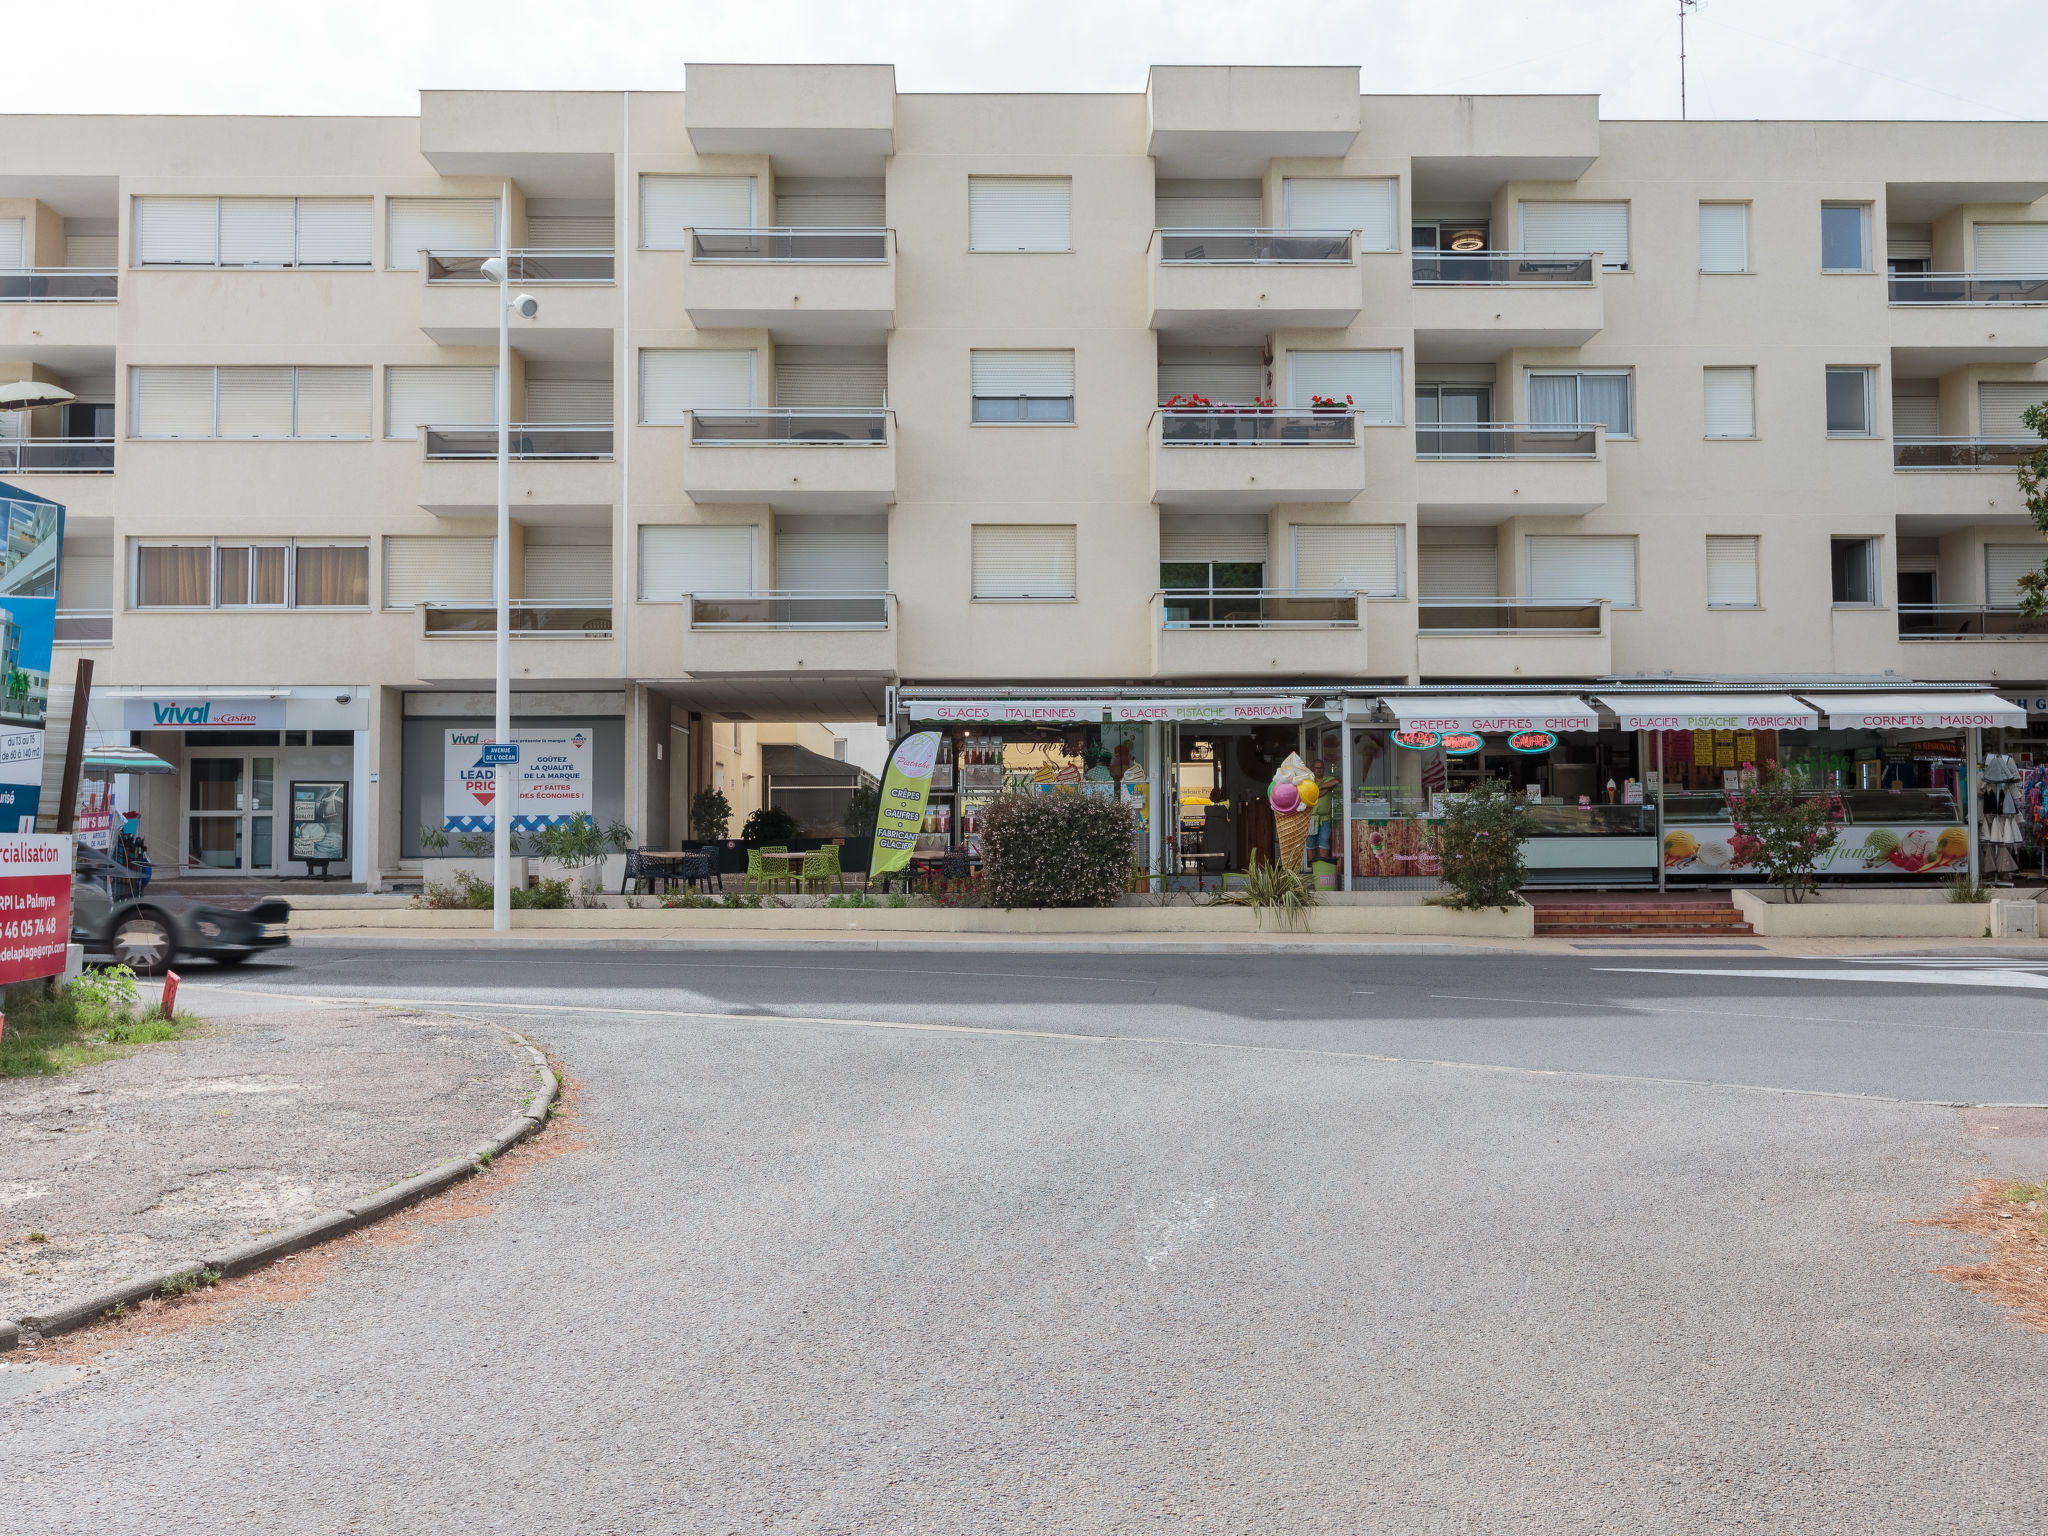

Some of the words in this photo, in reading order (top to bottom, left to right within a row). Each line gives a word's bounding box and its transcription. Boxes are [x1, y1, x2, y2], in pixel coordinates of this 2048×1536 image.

[153, 702, 211, 724] Vival
[221, 714, 256, 722] Casino
[937, 708, 990, 718] GLACES
[1005, 708, 1076, 718] ITALIENNES
[1120, 708, 1168, 718] GLACIER
[1176, 708, 1225, 717] PISTACHE
[1234, 706, 1294, 716] FABRICANT
[1410, 720, 1460, 730] CREPES
[1472, 719, 1532, 729] GAUFRES
[1545, 718, 1589, 729] CHICHI
[1630, 717, 1678, 727] GLACIER
[1688, 717, 1738, 726] PISTACHE
[1748, 716, 1808, 726] FABRICANT
[1863, 716, 1924, 726] CORNETS
[1940, 716, 1994, 725] MAISON
[8, 737, 15, 746] du
[22, 737, 30, 745] au
[452, 733, 480, 744] Vival
[2, 752, 10, 760] de
[460, 770, 496, 780] LEAD
[466, 782, 496, 791] PRIC
[890, 788, 920, 801] CRÊPES
[884, 808, 920, 821] GAUFRES
[878, 828, 919, 842] FABRICANT
[880, 840, 914, 850] GLACIER
[15, 895, 25, 910] La
[26, 893, 55, 911] Palmyre
[4, 920, 18, 939] 46
[20, 919, 33, 938] 05
[34, 918, 44, 936] 74
[46, 917, 56, 934] 48
[0, 941, 65, 962] delaplage@orpi.com
